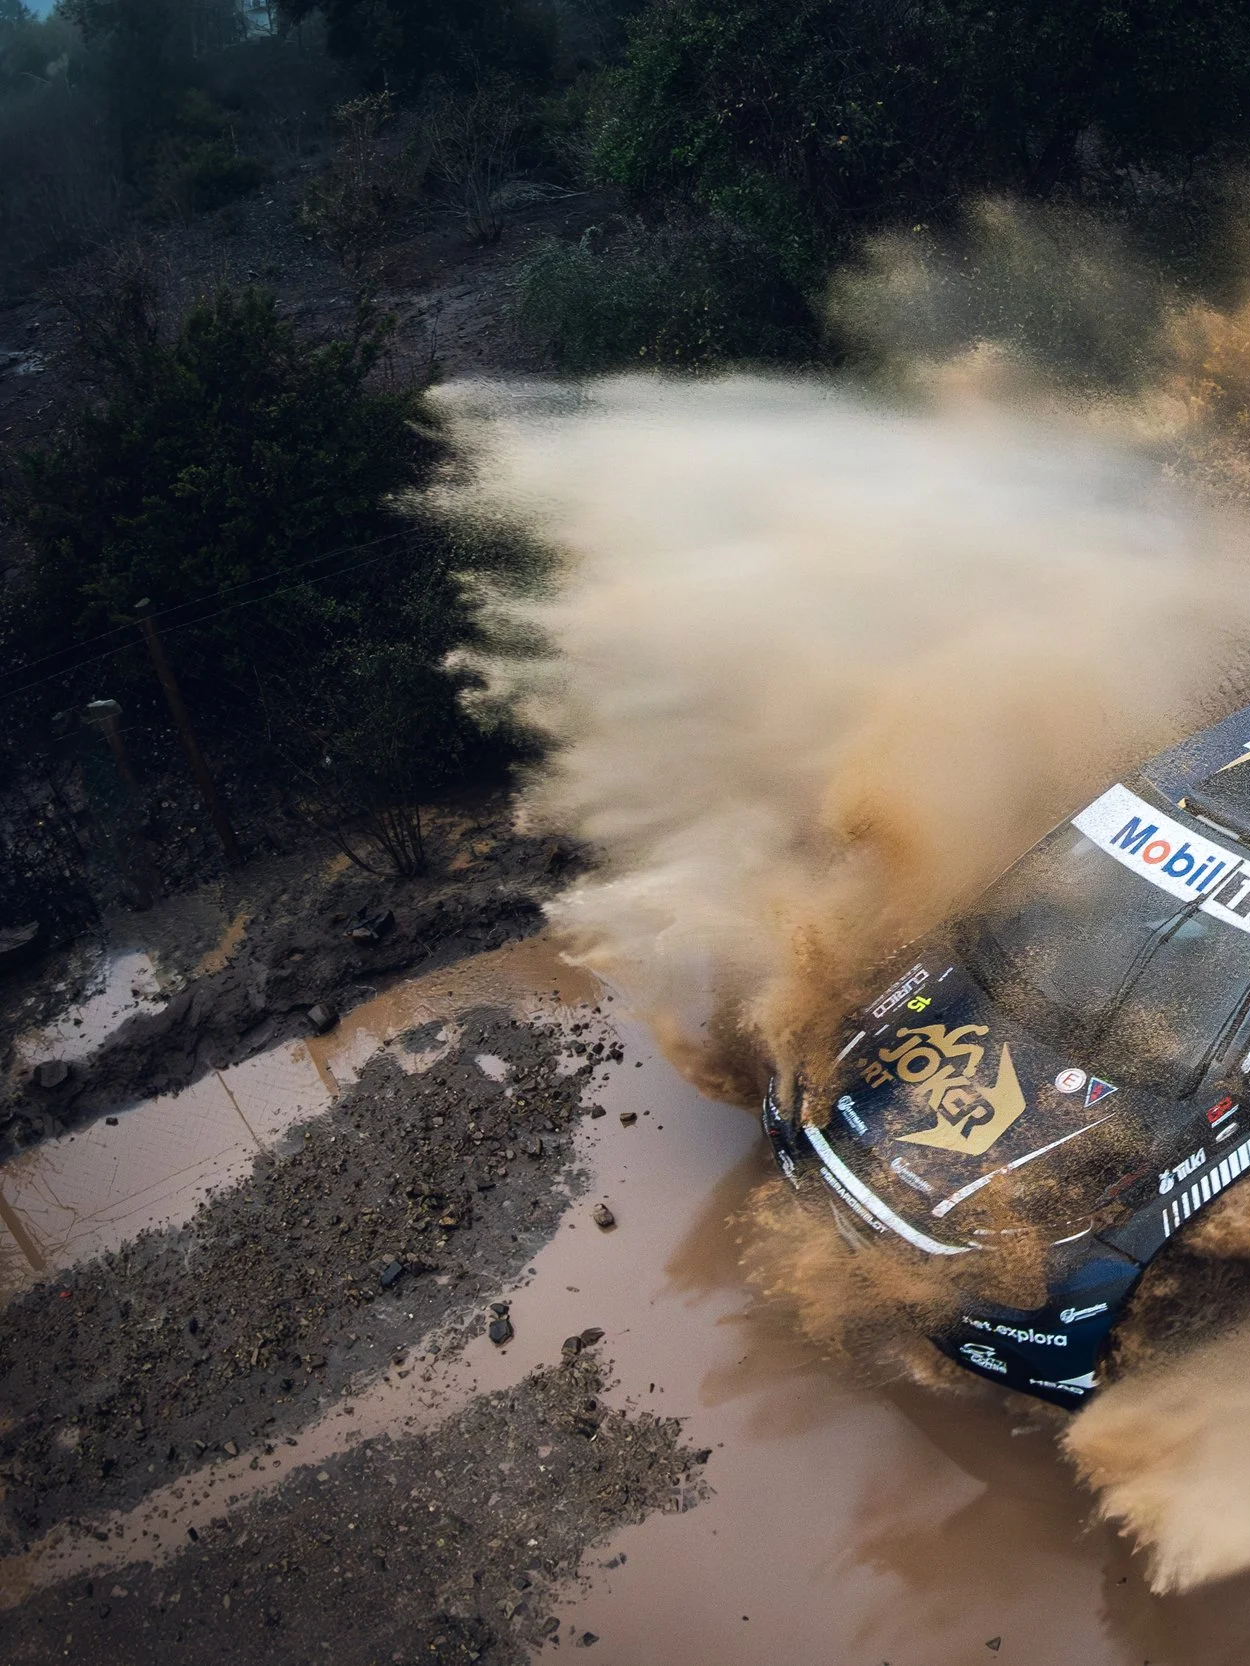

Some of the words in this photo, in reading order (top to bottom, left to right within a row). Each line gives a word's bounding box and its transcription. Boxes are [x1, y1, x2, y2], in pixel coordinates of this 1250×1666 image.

[1109, 815, 1227, 894] Mobil
[906, 995, 933, 1013] 15
[878, 1034, 997, 1140] JOKER
[994, 1324, 1069, 1347] explora
